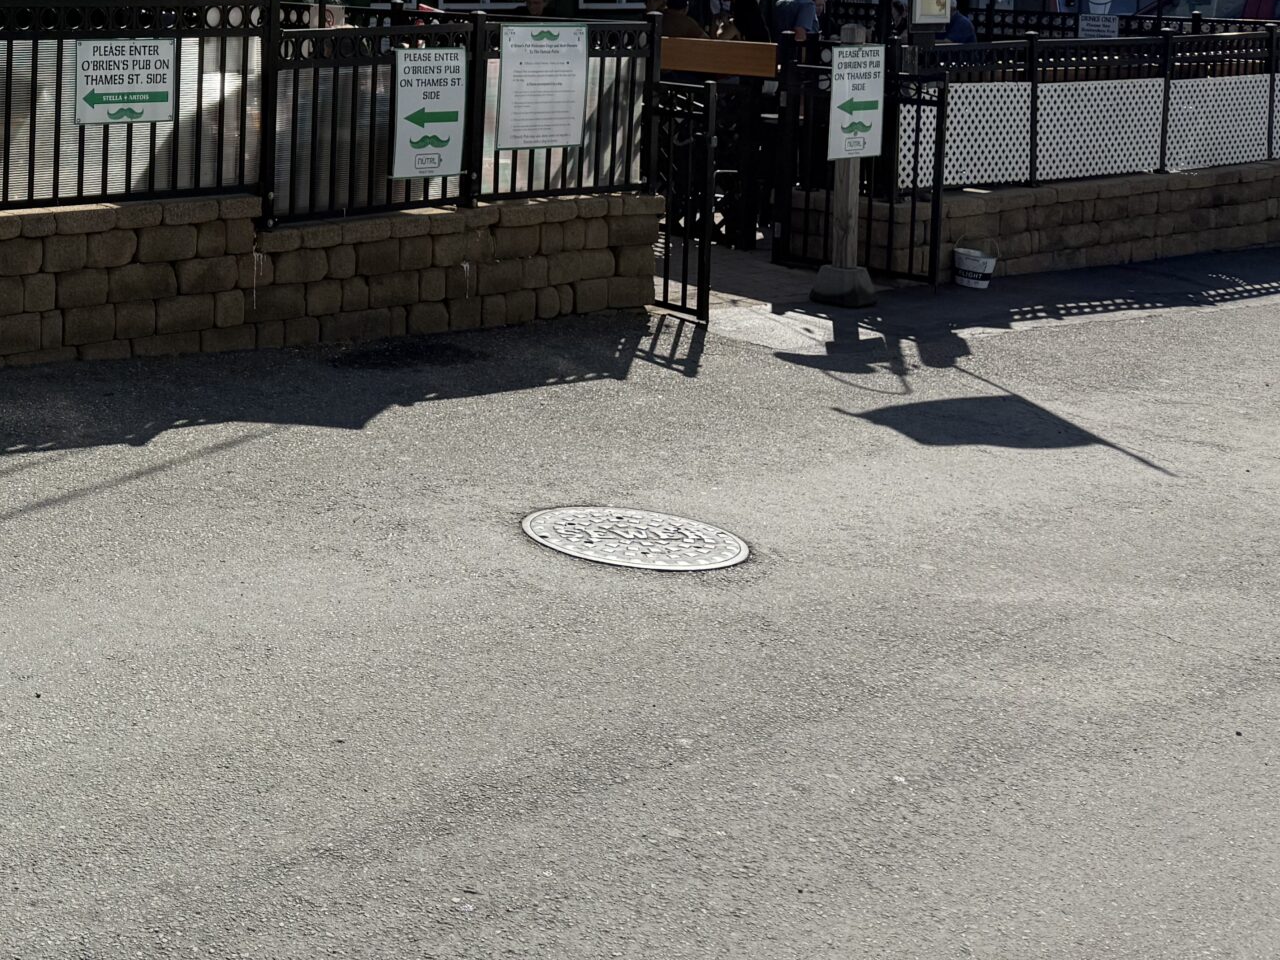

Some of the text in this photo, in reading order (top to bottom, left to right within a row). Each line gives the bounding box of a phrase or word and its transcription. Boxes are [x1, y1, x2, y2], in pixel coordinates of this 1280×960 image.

[92, 44, 159, 57] PLEASE ENTER
[838, 49, 880, 59] PLEASE ENTER
[404, 52, 459, 62] PLEASE ENTER
[81, 59, 170, 71] O'BRIEN'S PUB ON
[403, 65, 460, 75] O'BRIEN'S PUB
[837, 60, 881, 70] O'BRIEN'S PUB
[84, 73, 167, 86] THAMES ST. SIDE
[834, 73, 845, 81] ON
[847, 71, 872, 80] THAMES
[399, 78, 413, 88] ON
[416, 78, 449, 87] THAMES
[851, 83, 866, 91] SIDE
[422, 90, 441, 100] SIDE
